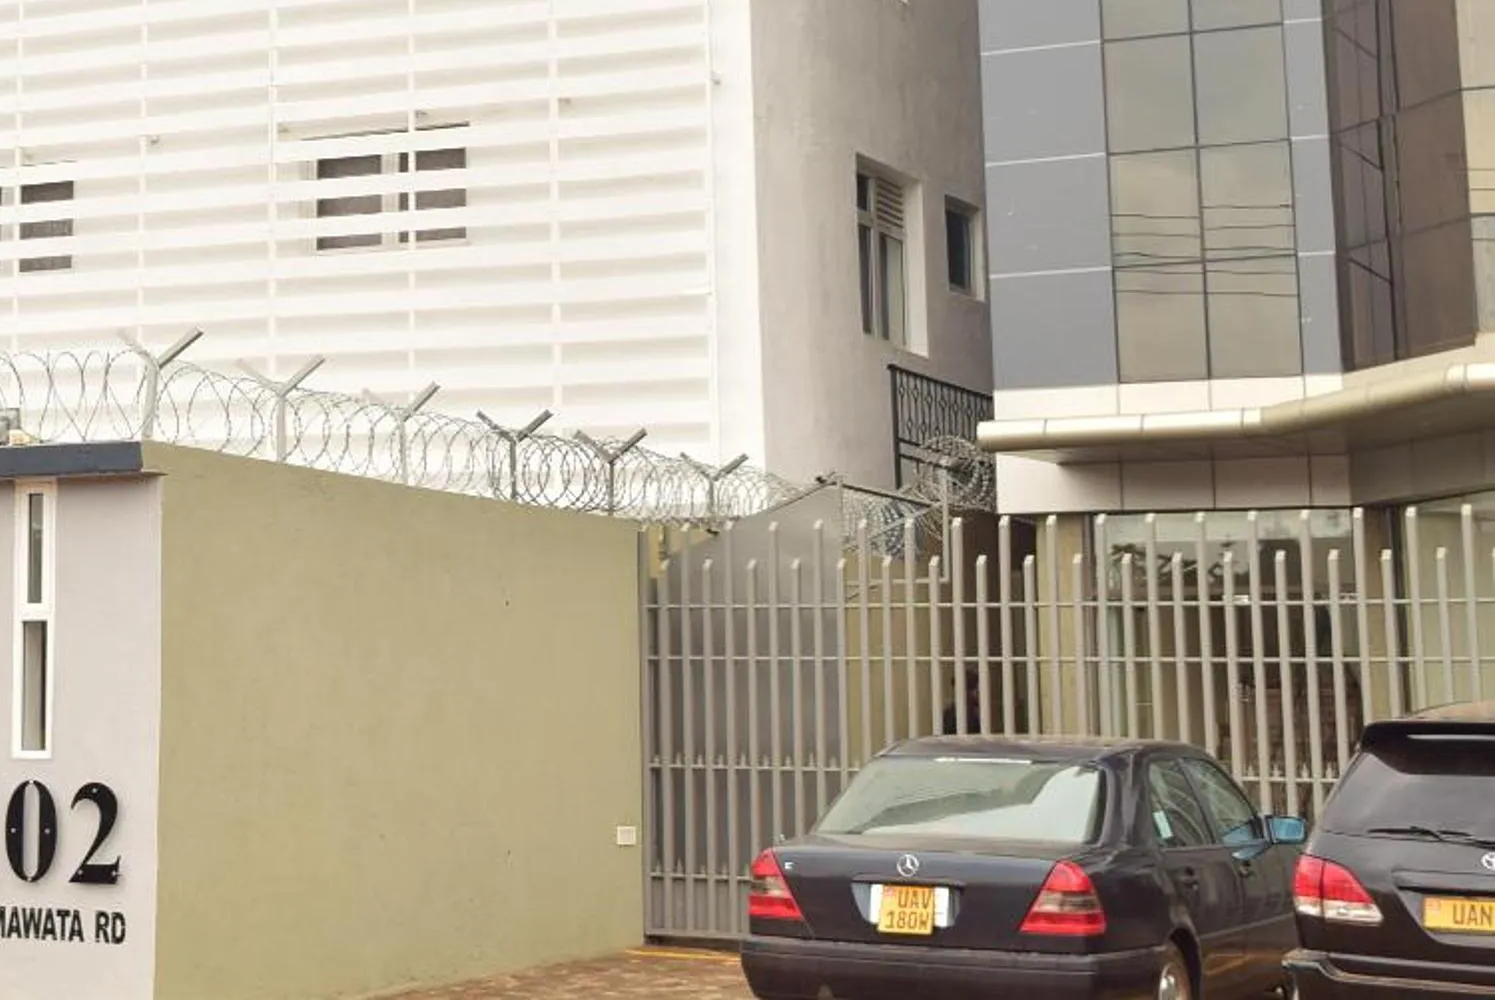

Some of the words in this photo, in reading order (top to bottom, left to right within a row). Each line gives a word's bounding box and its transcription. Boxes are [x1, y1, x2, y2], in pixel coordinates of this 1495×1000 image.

[897, 890, 932, 909] UAV
[94, 910, 127, 944] RD
[1452, 903, 1493, 928] UAN
